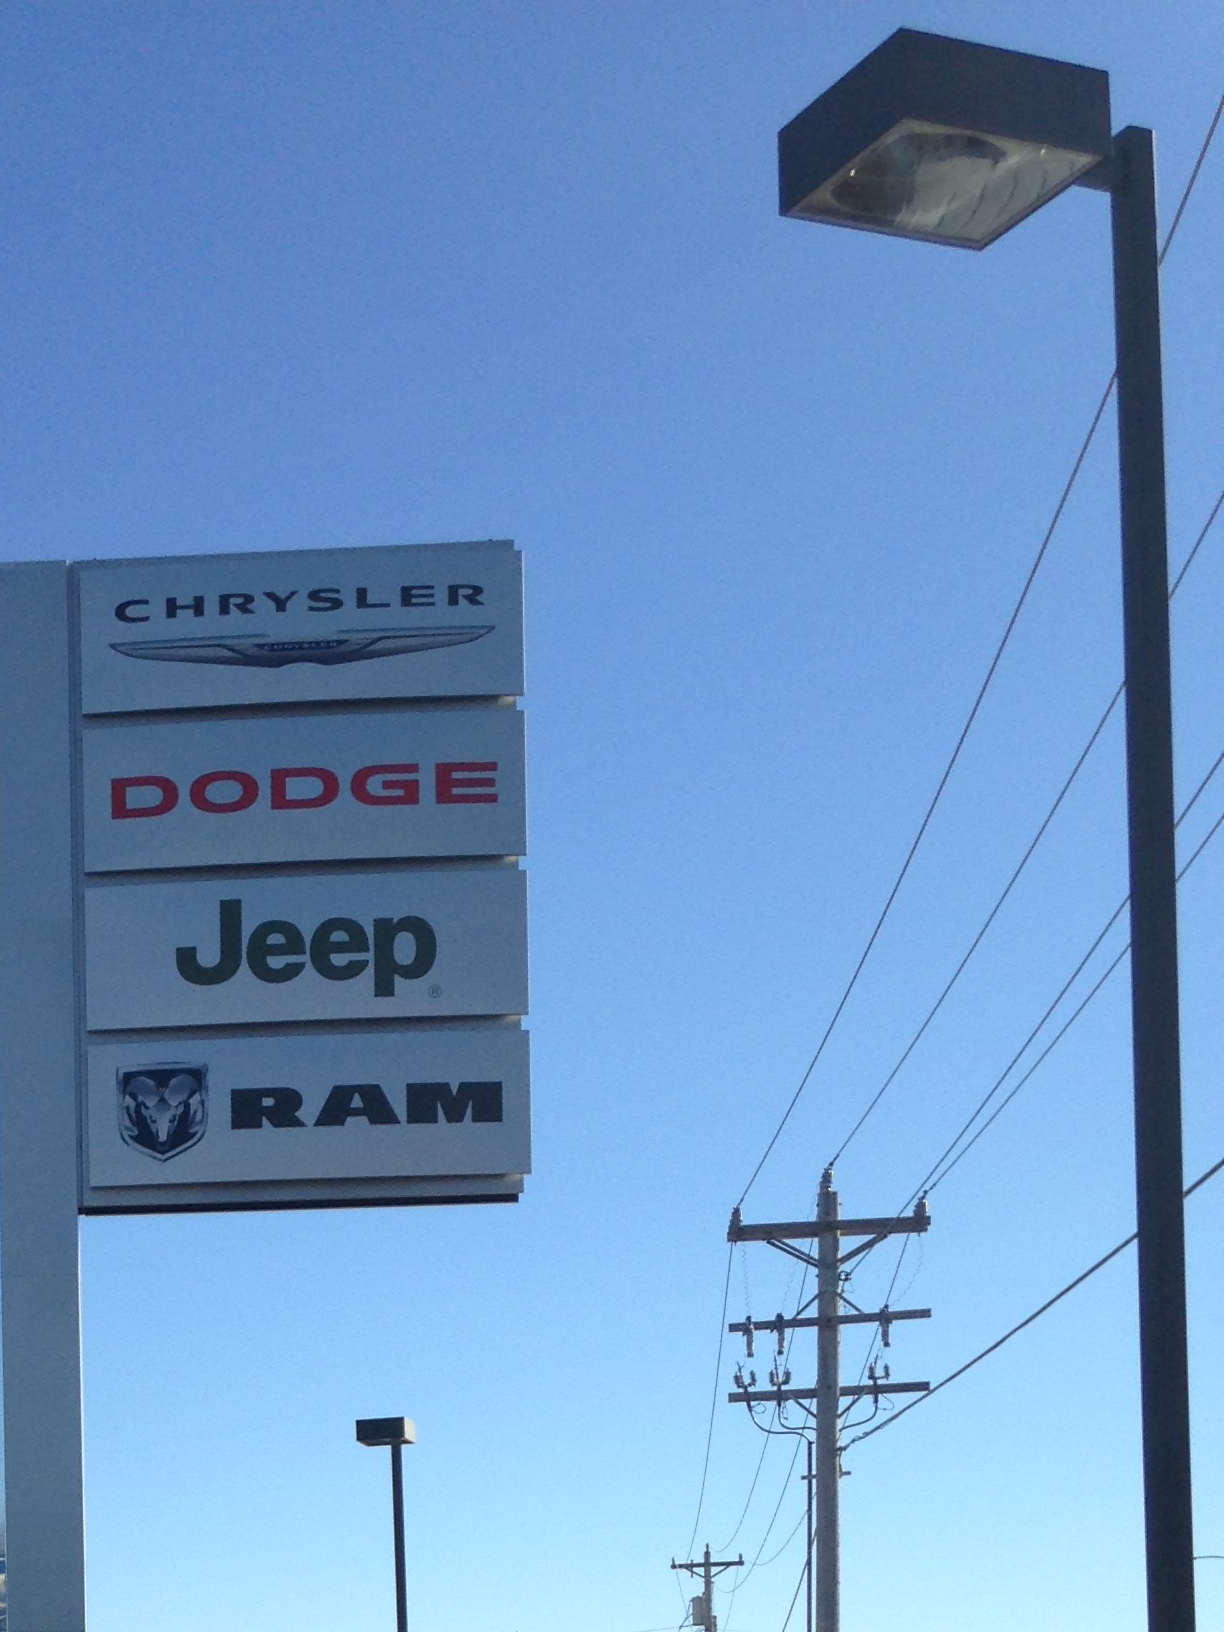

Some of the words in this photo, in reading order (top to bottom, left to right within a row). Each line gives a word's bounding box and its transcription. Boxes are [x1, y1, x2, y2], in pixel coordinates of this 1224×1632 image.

[114, 584, 486, 623] CHRYSLER
[110, 762, 499, 820] DODGE
[176, 898, 438, 998] Jeep
[230, 1081, 504, 1130] RAM
